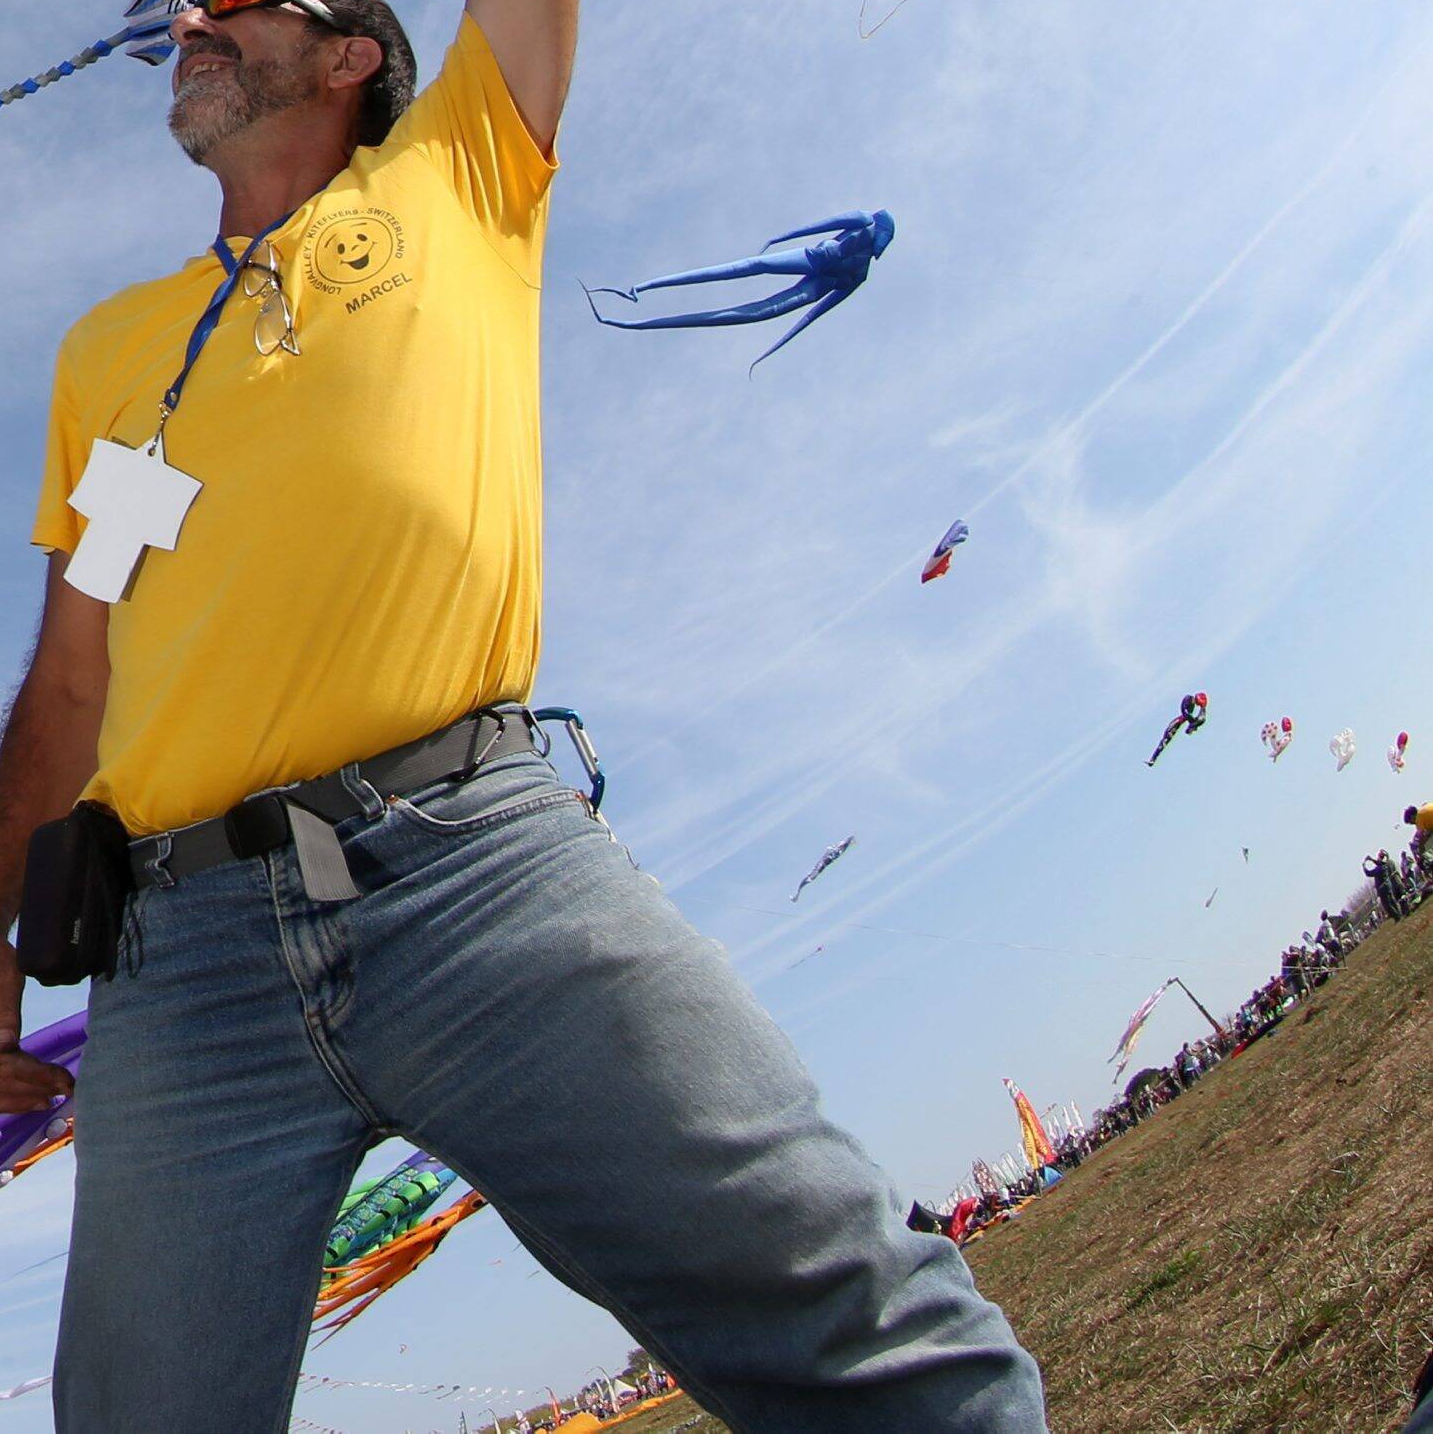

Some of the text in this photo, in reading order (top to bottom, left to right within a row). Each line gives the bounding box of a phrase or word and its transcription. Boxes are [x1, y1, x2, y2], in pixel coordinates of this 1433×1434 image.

[302, 207, 405, 295] LONGVALLEY KITEFLYERS SWITZERLAND
[345, 272, 412, 314] MARCEL
